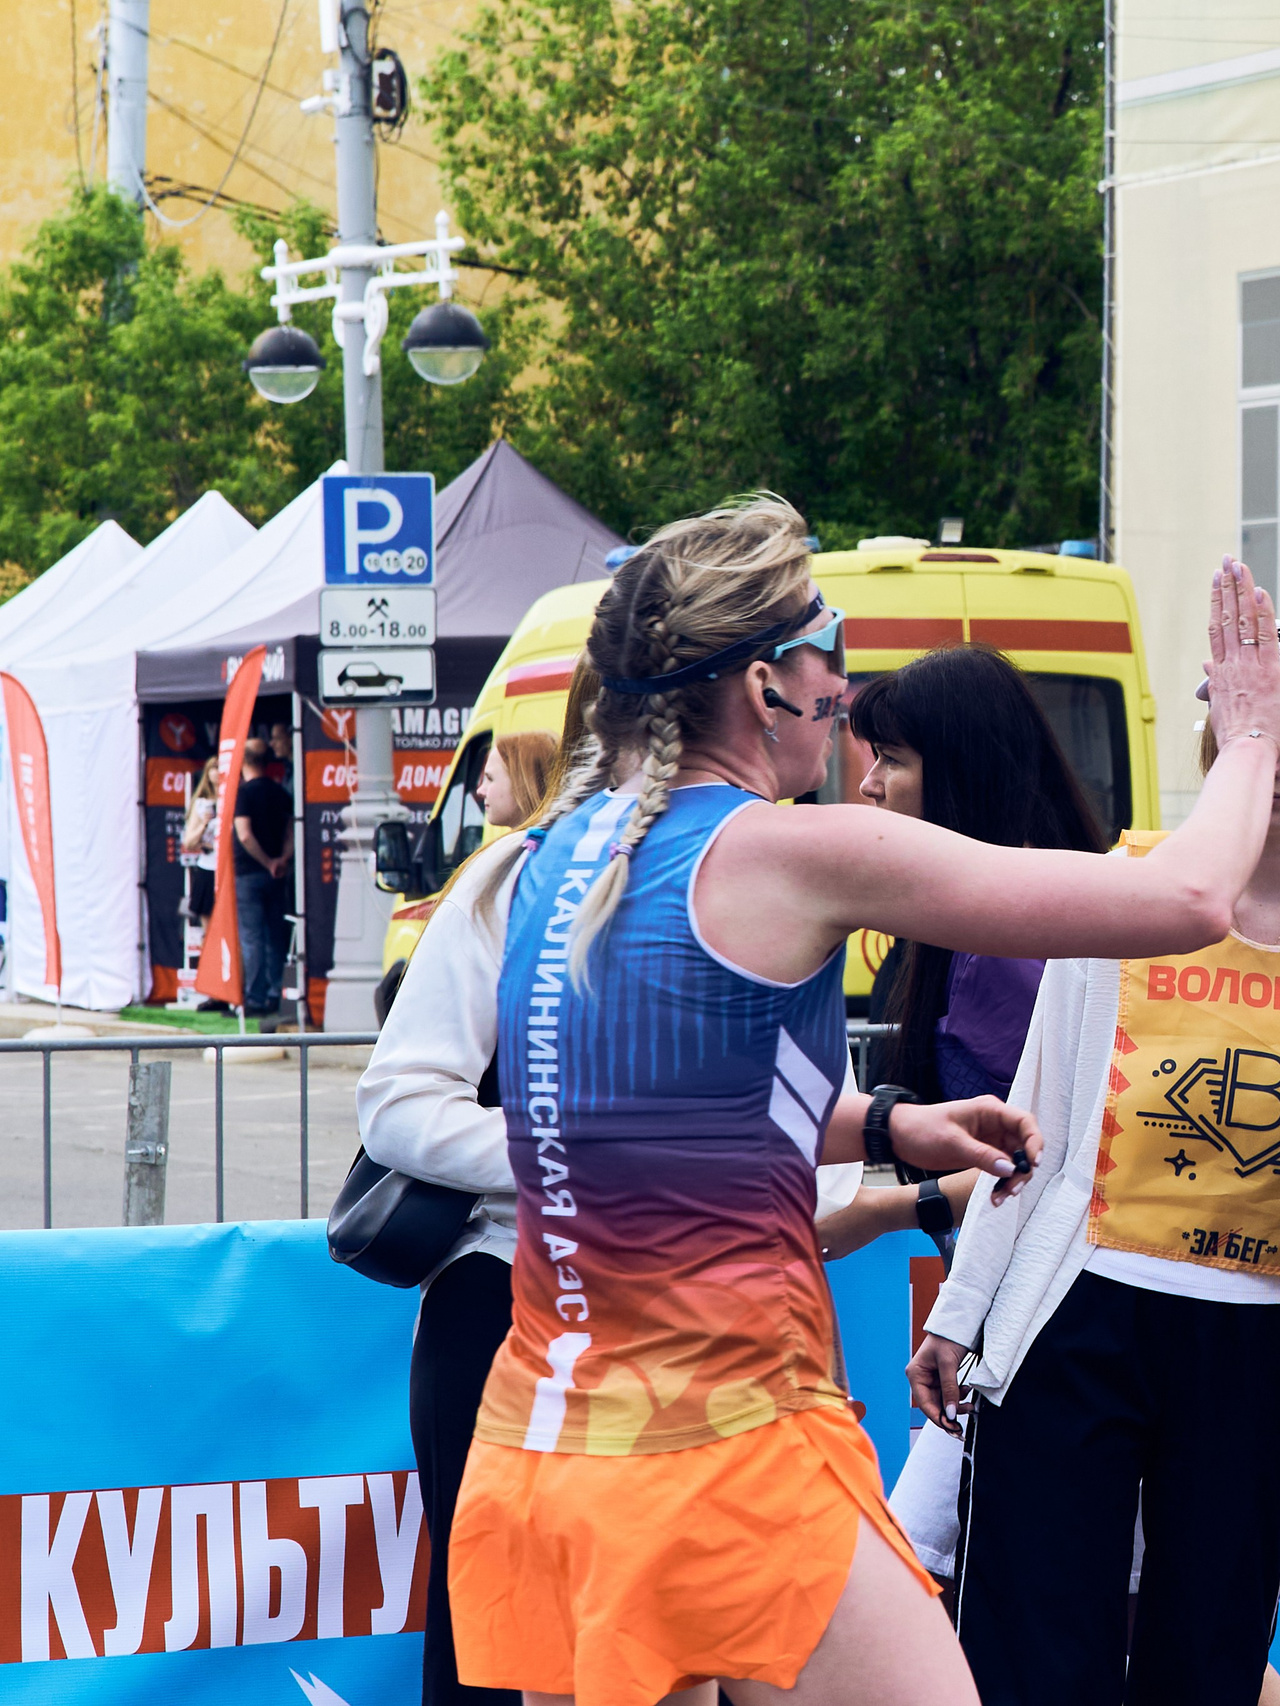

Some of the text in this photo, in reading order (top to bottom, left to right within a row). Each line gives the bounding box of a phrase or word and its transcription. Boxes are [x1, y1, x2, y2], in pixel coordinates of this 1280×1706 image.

[407, 555, 425, 570] 20
[329, 621, 427, 638] 8.00-18.00
[526, 868, 594, 1217] КАЛИНИНСКАЯ
[20, 1471, 426, 1664] КУЛЬТУ
